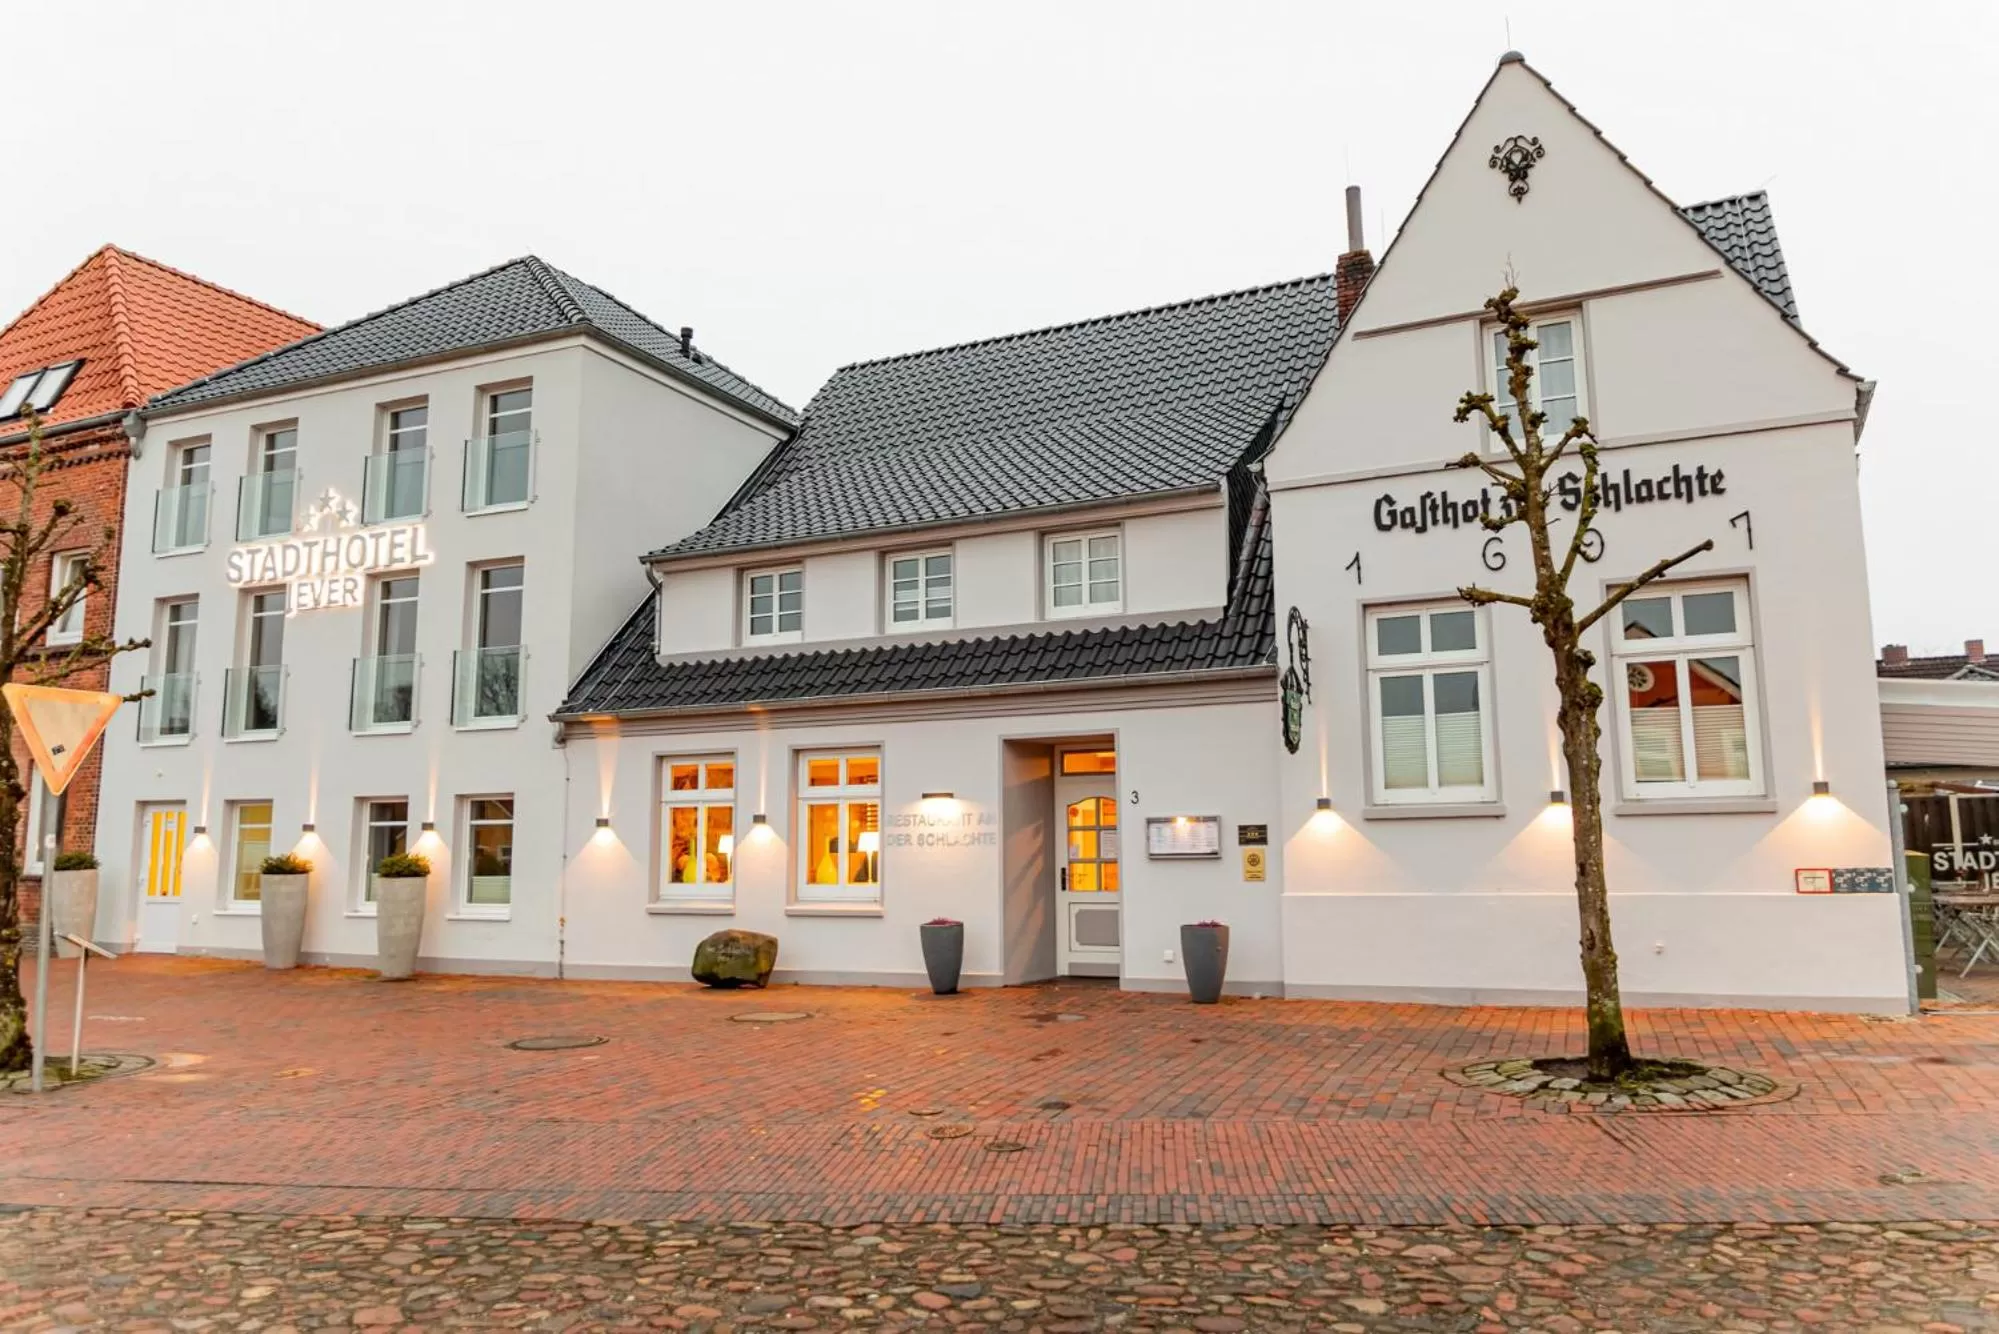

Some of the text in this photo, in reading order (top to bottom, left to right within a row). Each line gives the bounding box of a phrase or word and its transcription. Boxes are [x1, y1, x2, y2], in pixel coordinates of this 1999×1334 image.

[226, 527, 430, 584] STADTHOTEL
[284, 576, 359, 614] JEVER
[1130, 790, 1140, 805] 3
[887, 813, 973, 828] RESTAUT
